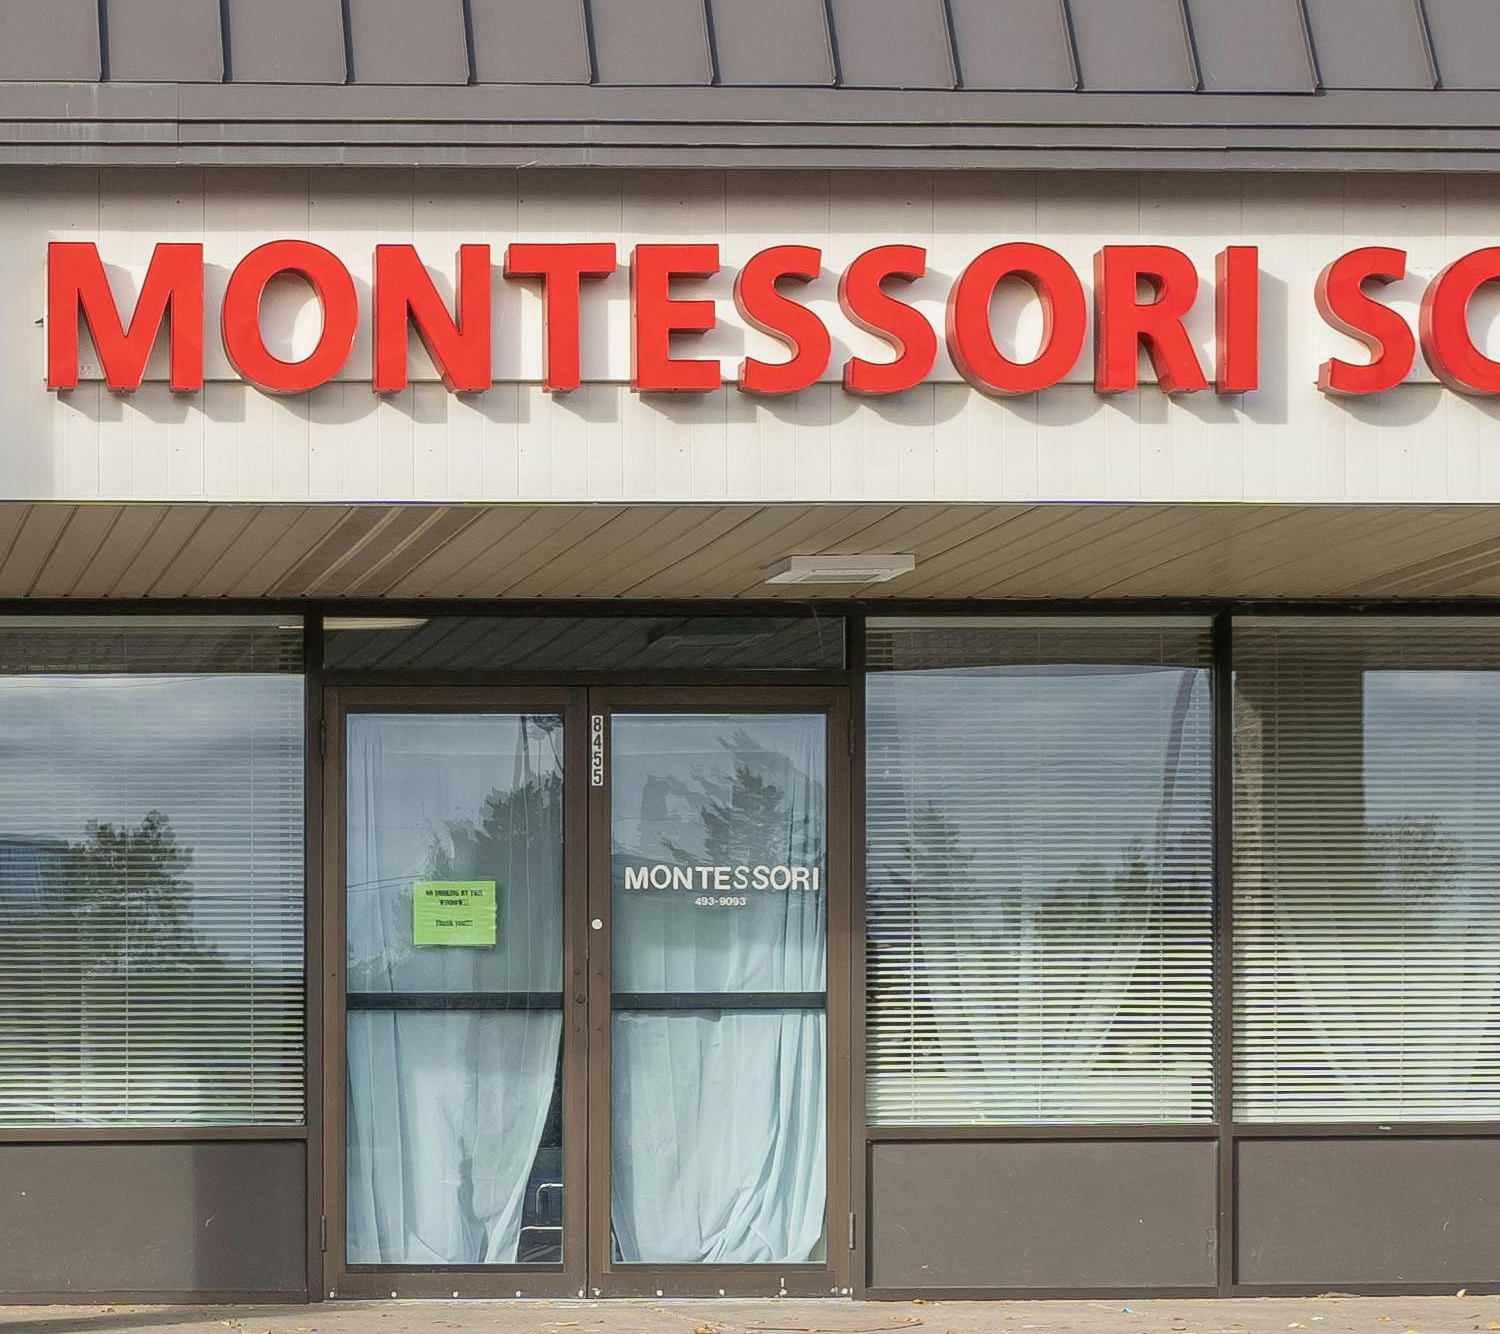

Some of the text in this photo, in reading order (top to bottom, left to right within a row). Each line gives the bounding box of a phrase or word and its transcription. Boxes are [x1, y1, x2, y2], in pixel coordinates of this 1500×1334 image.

[44, 239, 1260, 395] MONTESSORI
[592, 716, 602, 785] 8455
[624, 865, 819, 891] MONTESSORI
[695, 896, 746, 906] 493-9093
